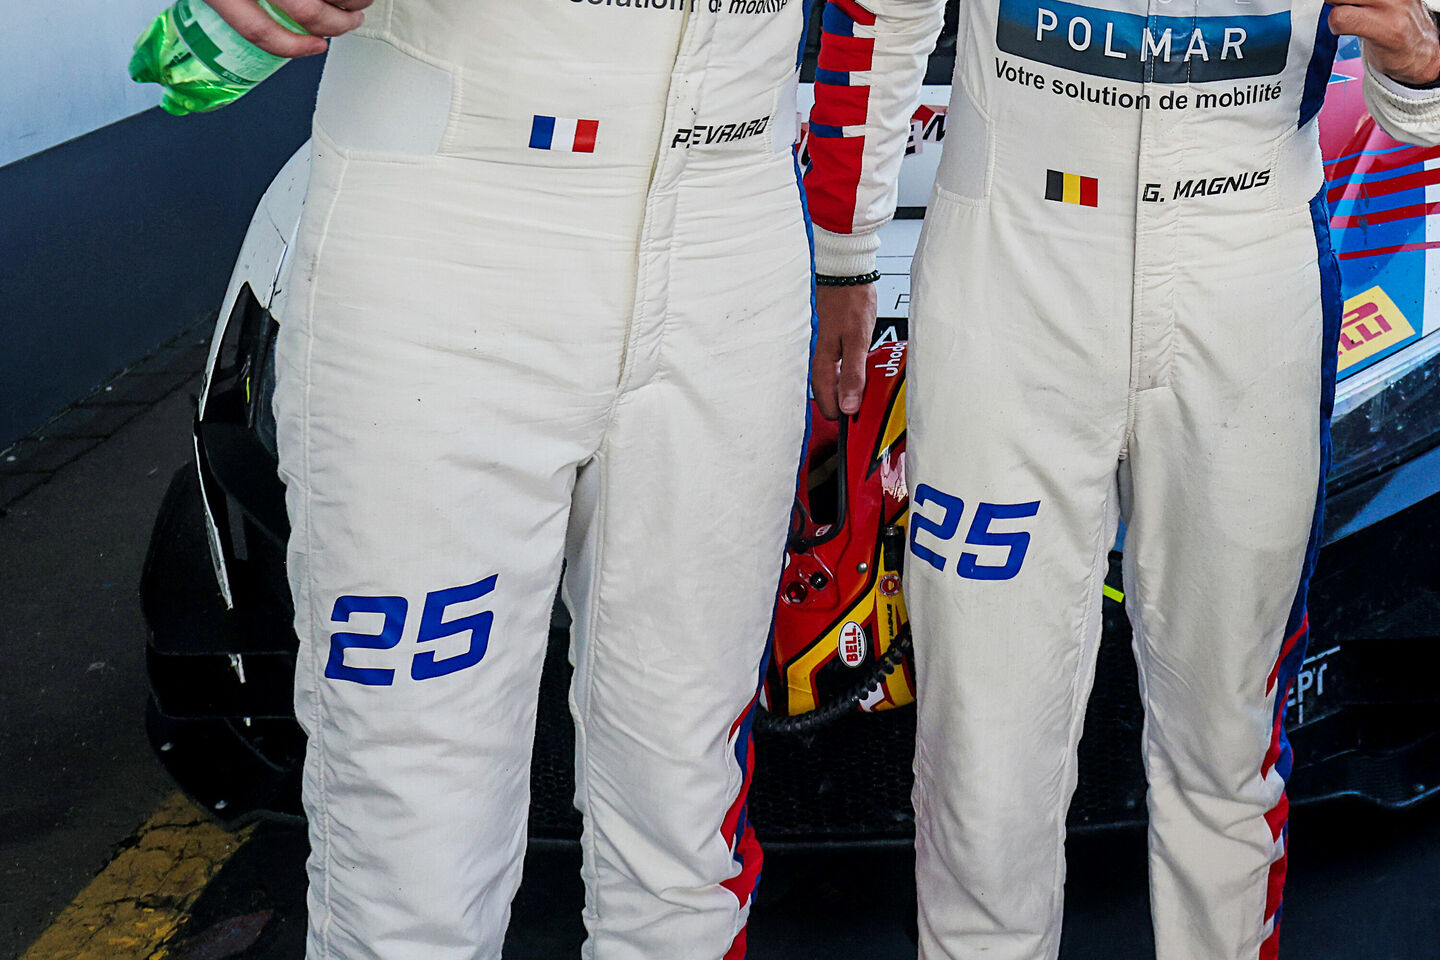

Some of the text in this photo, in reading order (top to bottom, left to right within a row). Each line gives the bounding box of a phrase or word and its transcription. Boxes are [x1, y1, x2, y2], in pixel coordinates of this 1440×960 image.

[1036, 7, 1248, 63] POLMAR
[994, 57, 1282, 110] Votre solution de mobilité
[1142, 169, 1272, 203] G. MAGNUS
[909, 483, 1042, 581] 25
[323, 572, 500, 687] 25
